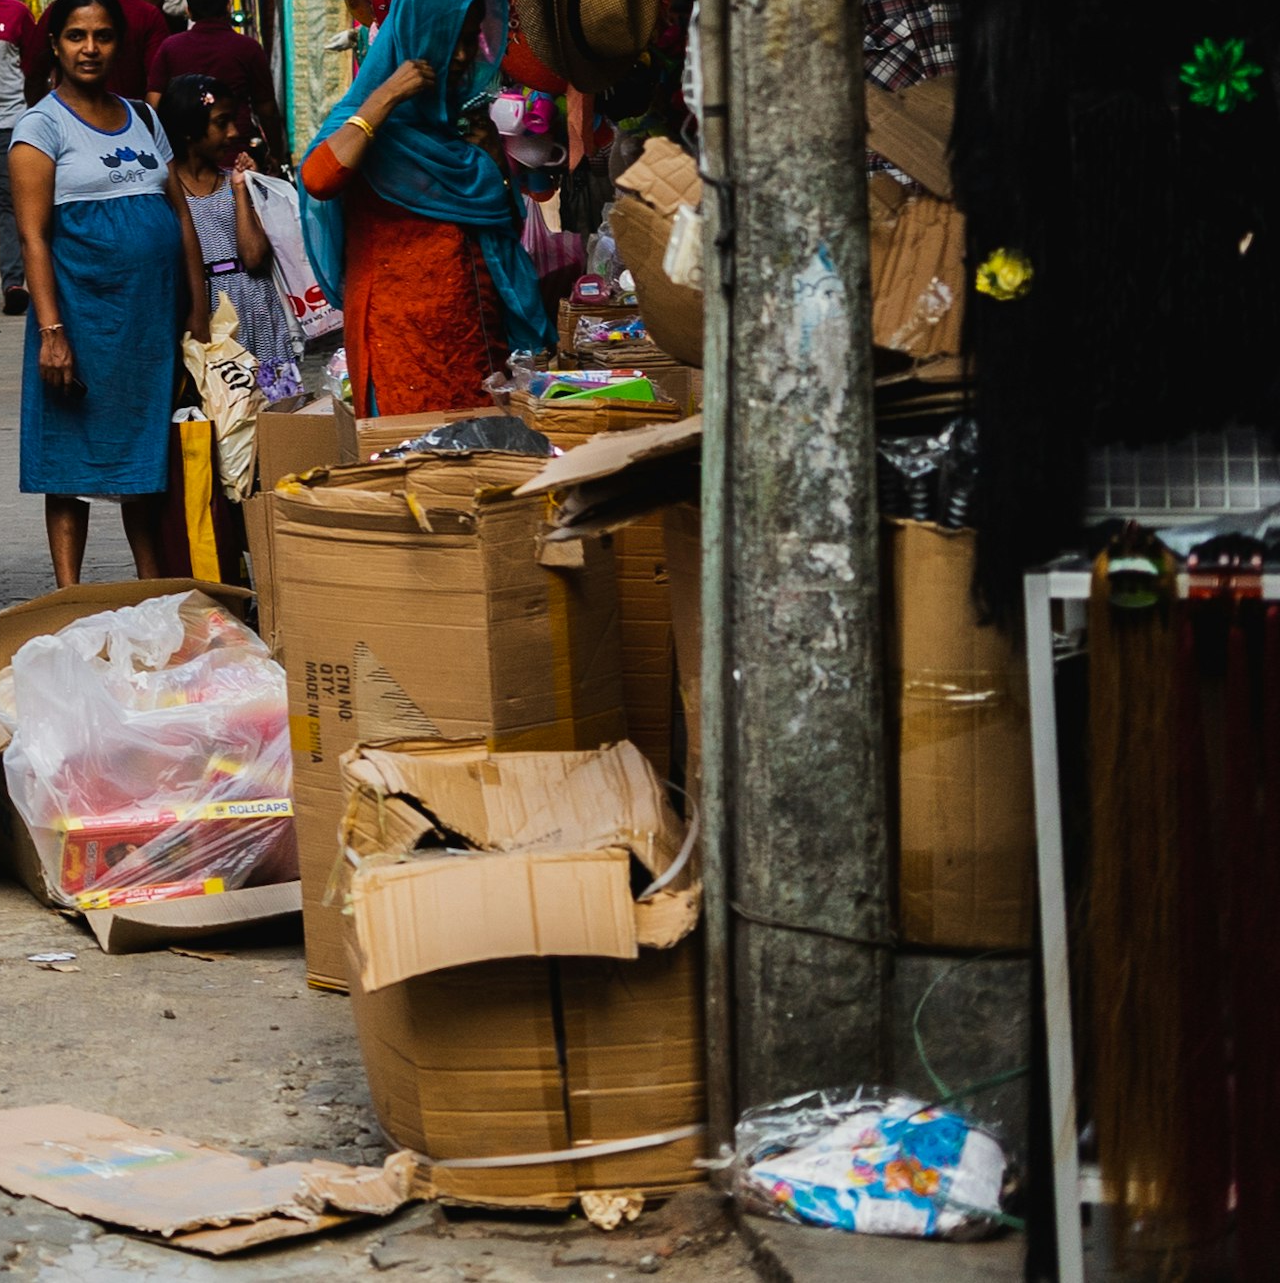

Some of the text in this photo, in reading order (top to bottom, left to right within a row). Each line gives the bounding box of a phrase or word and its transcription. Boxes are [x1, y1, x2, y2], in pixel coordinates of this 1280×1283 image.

[335, 663, 351, 695] CTN
[305, 661, 324, 764] MADE IN CHINA
[228, 801, 289, 815] ROLLCAPS
